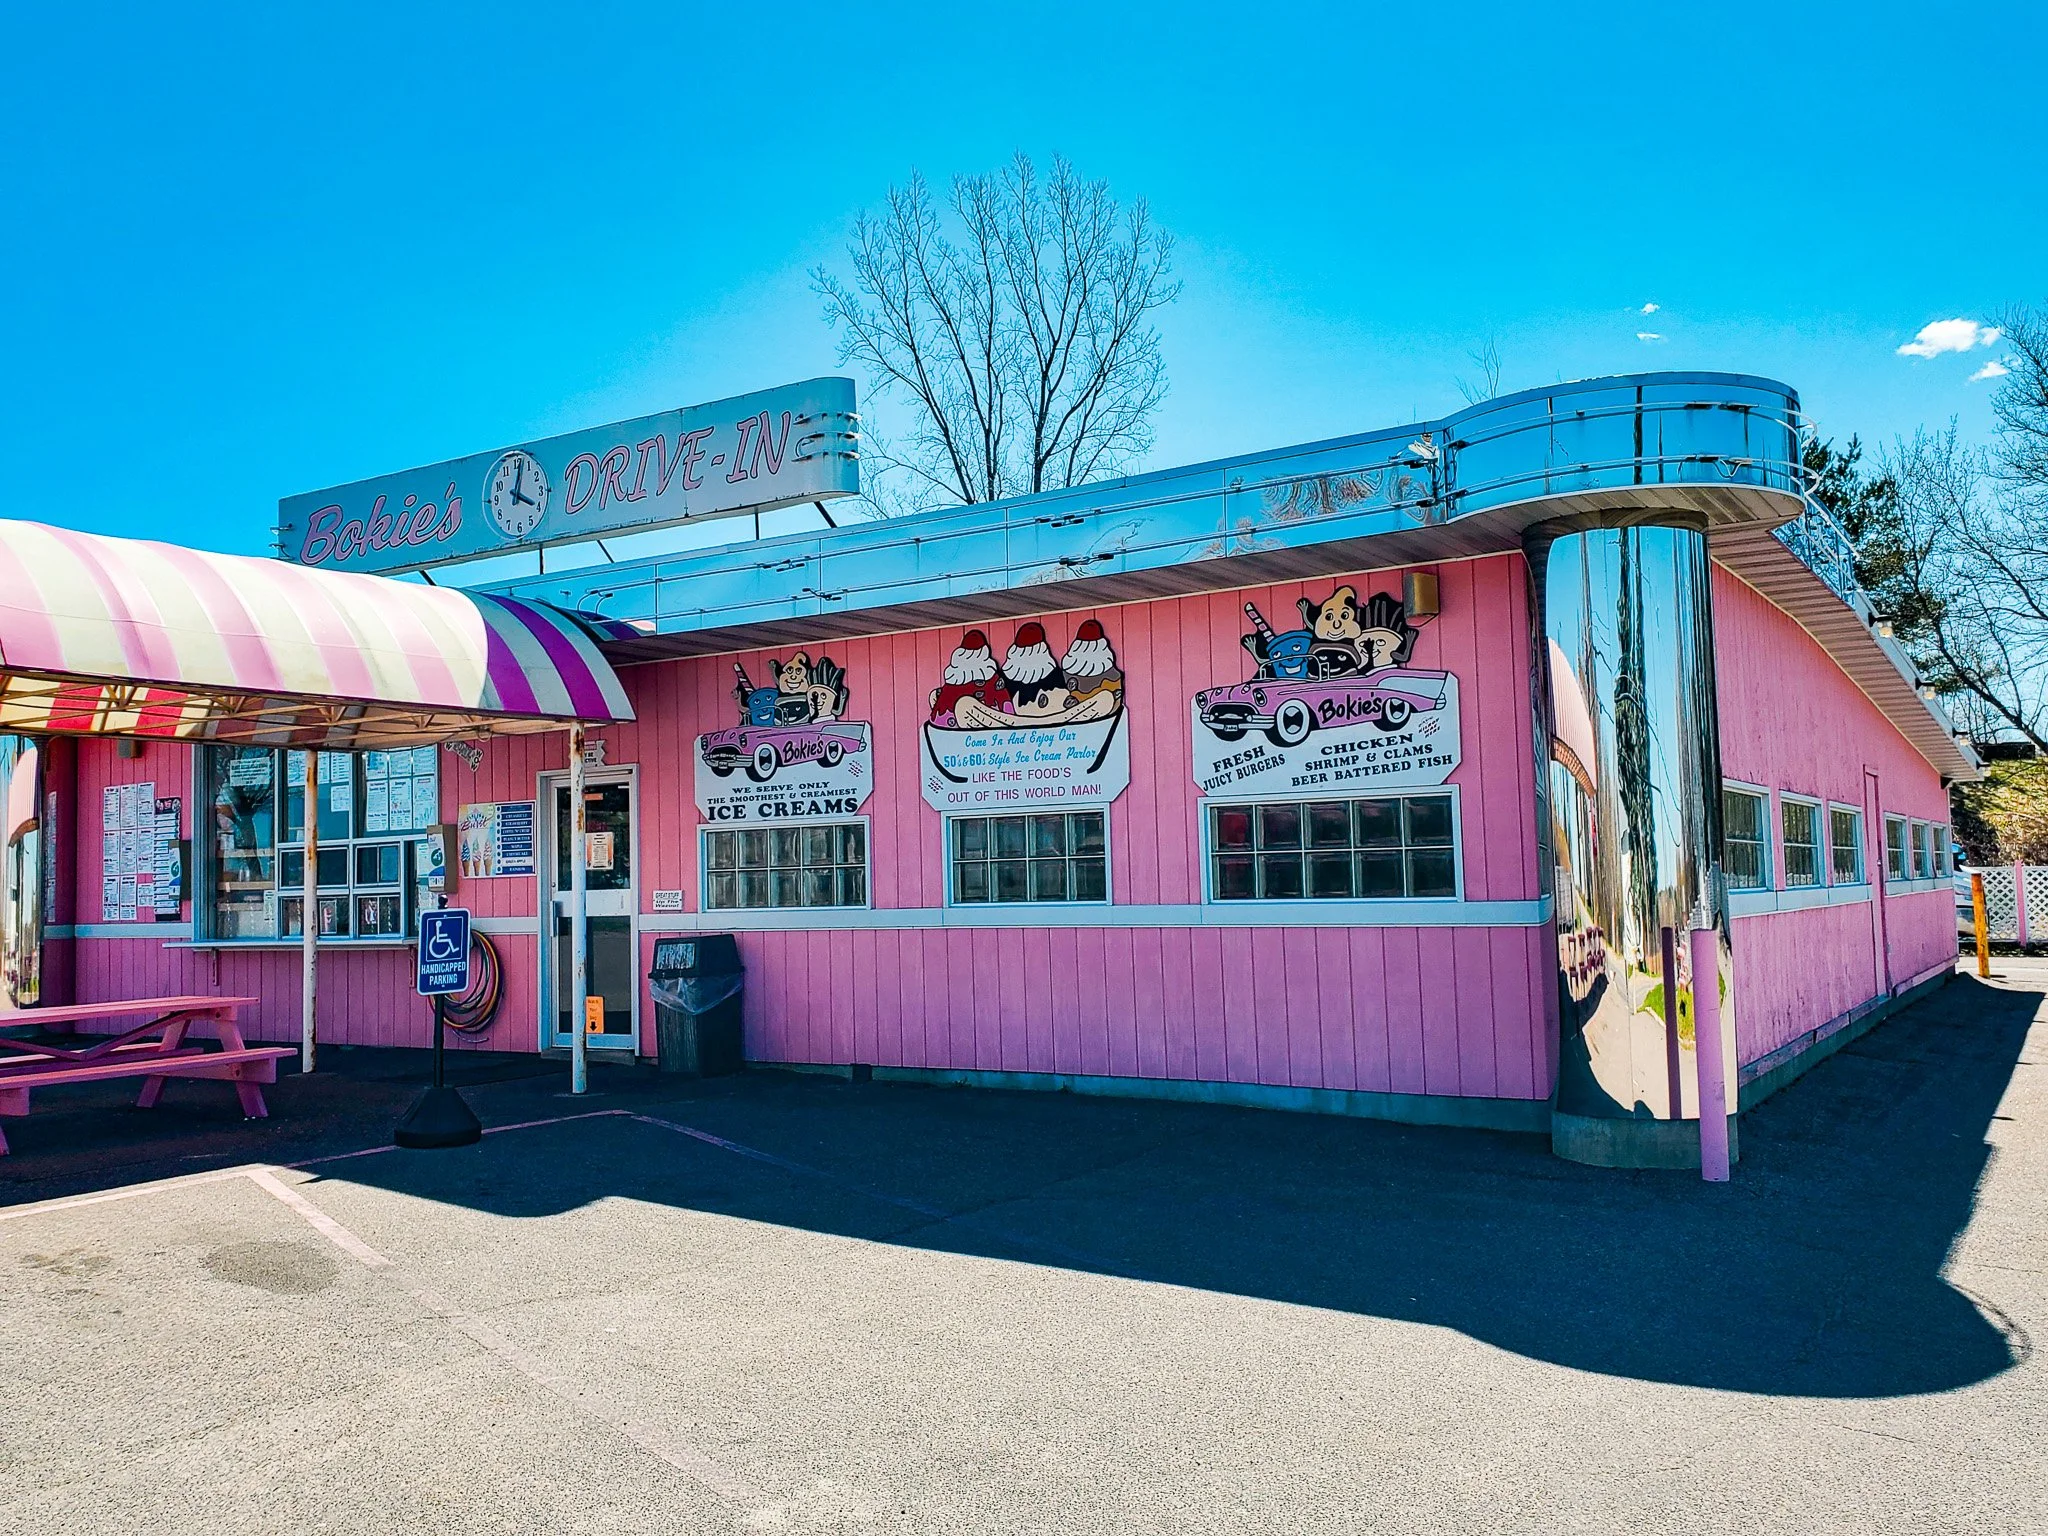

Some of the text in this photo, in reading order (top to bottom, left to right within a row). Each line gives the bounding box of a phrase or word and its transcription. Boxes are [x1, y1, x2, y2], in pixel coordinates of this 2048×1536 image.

[513, 458, 521, 469] 12
[527, 460, 531, 471] 1
[502, 466, 509, 477] 11
[534, 471, 539, 482] 2
[300, 410, 792, 565] Bokie's DRIVE-IN
[496, 480, 504, 492] 10
[538, 486, 544, 496] 3
[494, 495, 499, 505] 9
[536, 501, 541, 512] 4
[497, 509, 502, 520] 8
[529, 515, 534, 526] 5
[506, 520, 511, 530] 7
[517, 522, 523, 533] 6
[1317, 691, 1383, 724] Bokie's
[965, 728, 1076, 748] Come In And Enjoy Our
[1320, 733, 1414, 756] CHICKEN
[783, 736, 824, 763] Bokie's
[988, 752, 1011, 769] Style
[1015, 751, 1030, 763] Ice
[1034, 748, 1062, 761] Cream
[1066, 745, 1096, 760] Parlor
[1212, 745, 1266, 773] FRESH
[1304, 744, 1434, 772] SHRIMP & CLAMS
[972, 767, 1072, 784] LIKE THE FOOD'S
[1203, 753, 1287, 792] JUICY BURGERS
[1291, 754, 1454, 787] BEER BATTERED FISH
[756, 784, 794, 793] SERVE
[798, 781, 830, 790] ONLY
[947, 784, 1102, 803] OUT OF THIS WORLD MAN!
[729, 793, 786, 803] SMOOTHEST
[789, 791, 797, 799] &
[800, 788, 857, 798] CREAMIEST
[707, 797, 858, 820] ICE CREAMS
[421, 961, 466, 975] HANDICAPPED
[429, 973, 458, 986] PARKING
